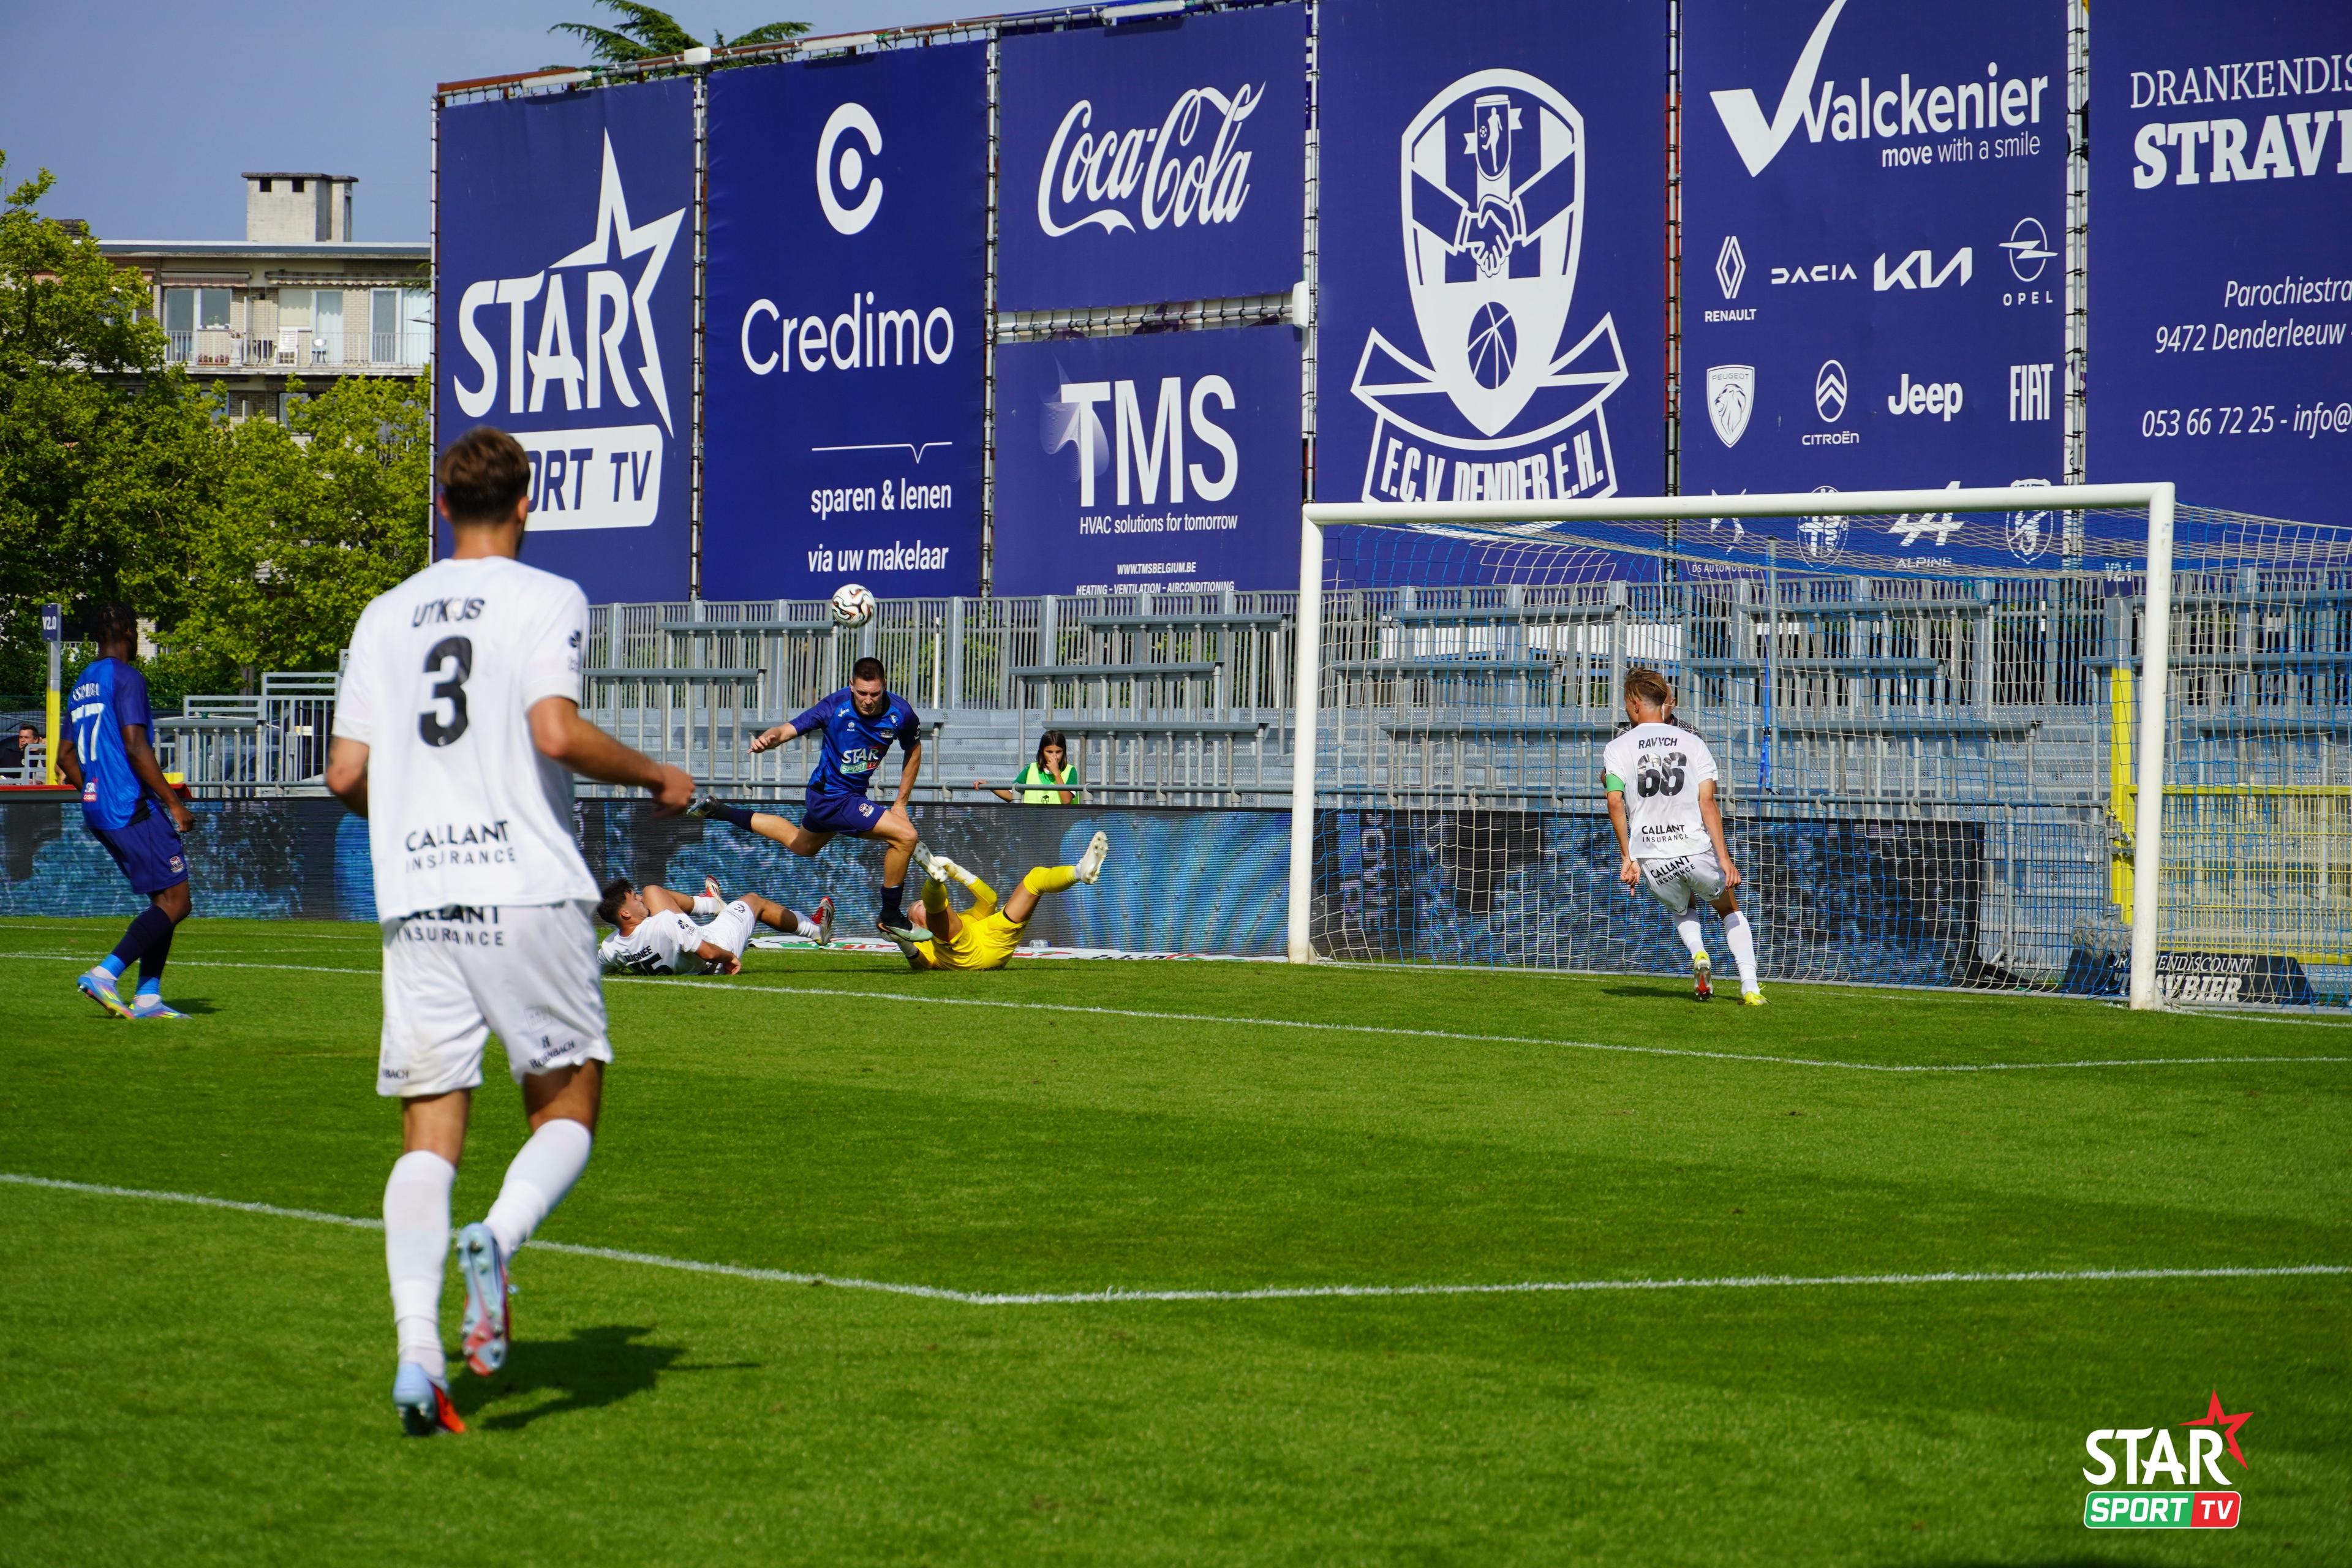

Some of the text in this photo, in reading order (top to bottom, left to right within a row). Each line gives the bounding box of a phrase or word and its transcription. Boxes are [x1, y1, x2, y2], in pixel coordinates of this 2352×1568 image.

[1037, 81, 1266, 238] Coca-Cola
[1882, 131, 2040, 168] move with a smile
[1771, 263, 1857, 284] DACIA
[2003, 290, 2053, 306] OPEL
[2224, 276, 2352, 307] Parochiestra
[1705, 309, 1757, 322] RENAULT
[454, 270, 641, 418] STAR
[741, 292, 954, 375] Credimo
[2155, 318, 2346, 353] 9472 Denderleeuw
[1711, 372, 1750, 382] PEUGEOT
[2010, 363, 2054, 421] FIAT
[1888, 374, 1963, 422] Jeep
[2142, 409, 2180, 437] 053
[2187, 408, 2212, 435] 66
[2218, 407, 2244, 434] 72
[2248, 405, 2275, 433] 25
[1061, 375, 1238, 507] TMS
[527, 448, 652, 513] ORT TV
[1452, 453, 1550, 502] DENDER
[1552, 429, 1604, 500] E.H.
[811, 477, 952, 520] sparen & lenen
[1080, 513, 1238, 535] HVAC solutions for tomorrow
[809, 540, 949, 573] via uw makelaar
[1117, 562, 1197, 575] WWW.TMSBELGIUM.BE
[1896, 557, 1952, 568] ALPINE
[1076, 584, 1107, 595] HEATING
[1114, 582, 1161, 595] VENTILATION
[1167, 581, 1235, 594] AIRCONDITIONING
[41, 615, 57, 630] V2.0
[419, 635, 472, 747] 3
[71, 703, 105, 765] 77
[1638, 737, 1678, 750] RAVYCH
[841, 762, 867, 772] SPORT
[842, 748, 879, 764] STAR
[1637, 752, 1687, 798] 66
[1642, 824, 1685, 835] CALLANT
[1642, 834, 1689, 843] INSURANCE
[1650, 856, 1691, 880] CALLANT
[1656, 864, 1696, 886] INSURANCE
[397, 926, 504, 946] INSURANCE
[2109, 953, 2253, 973] RENDISCOUNT
